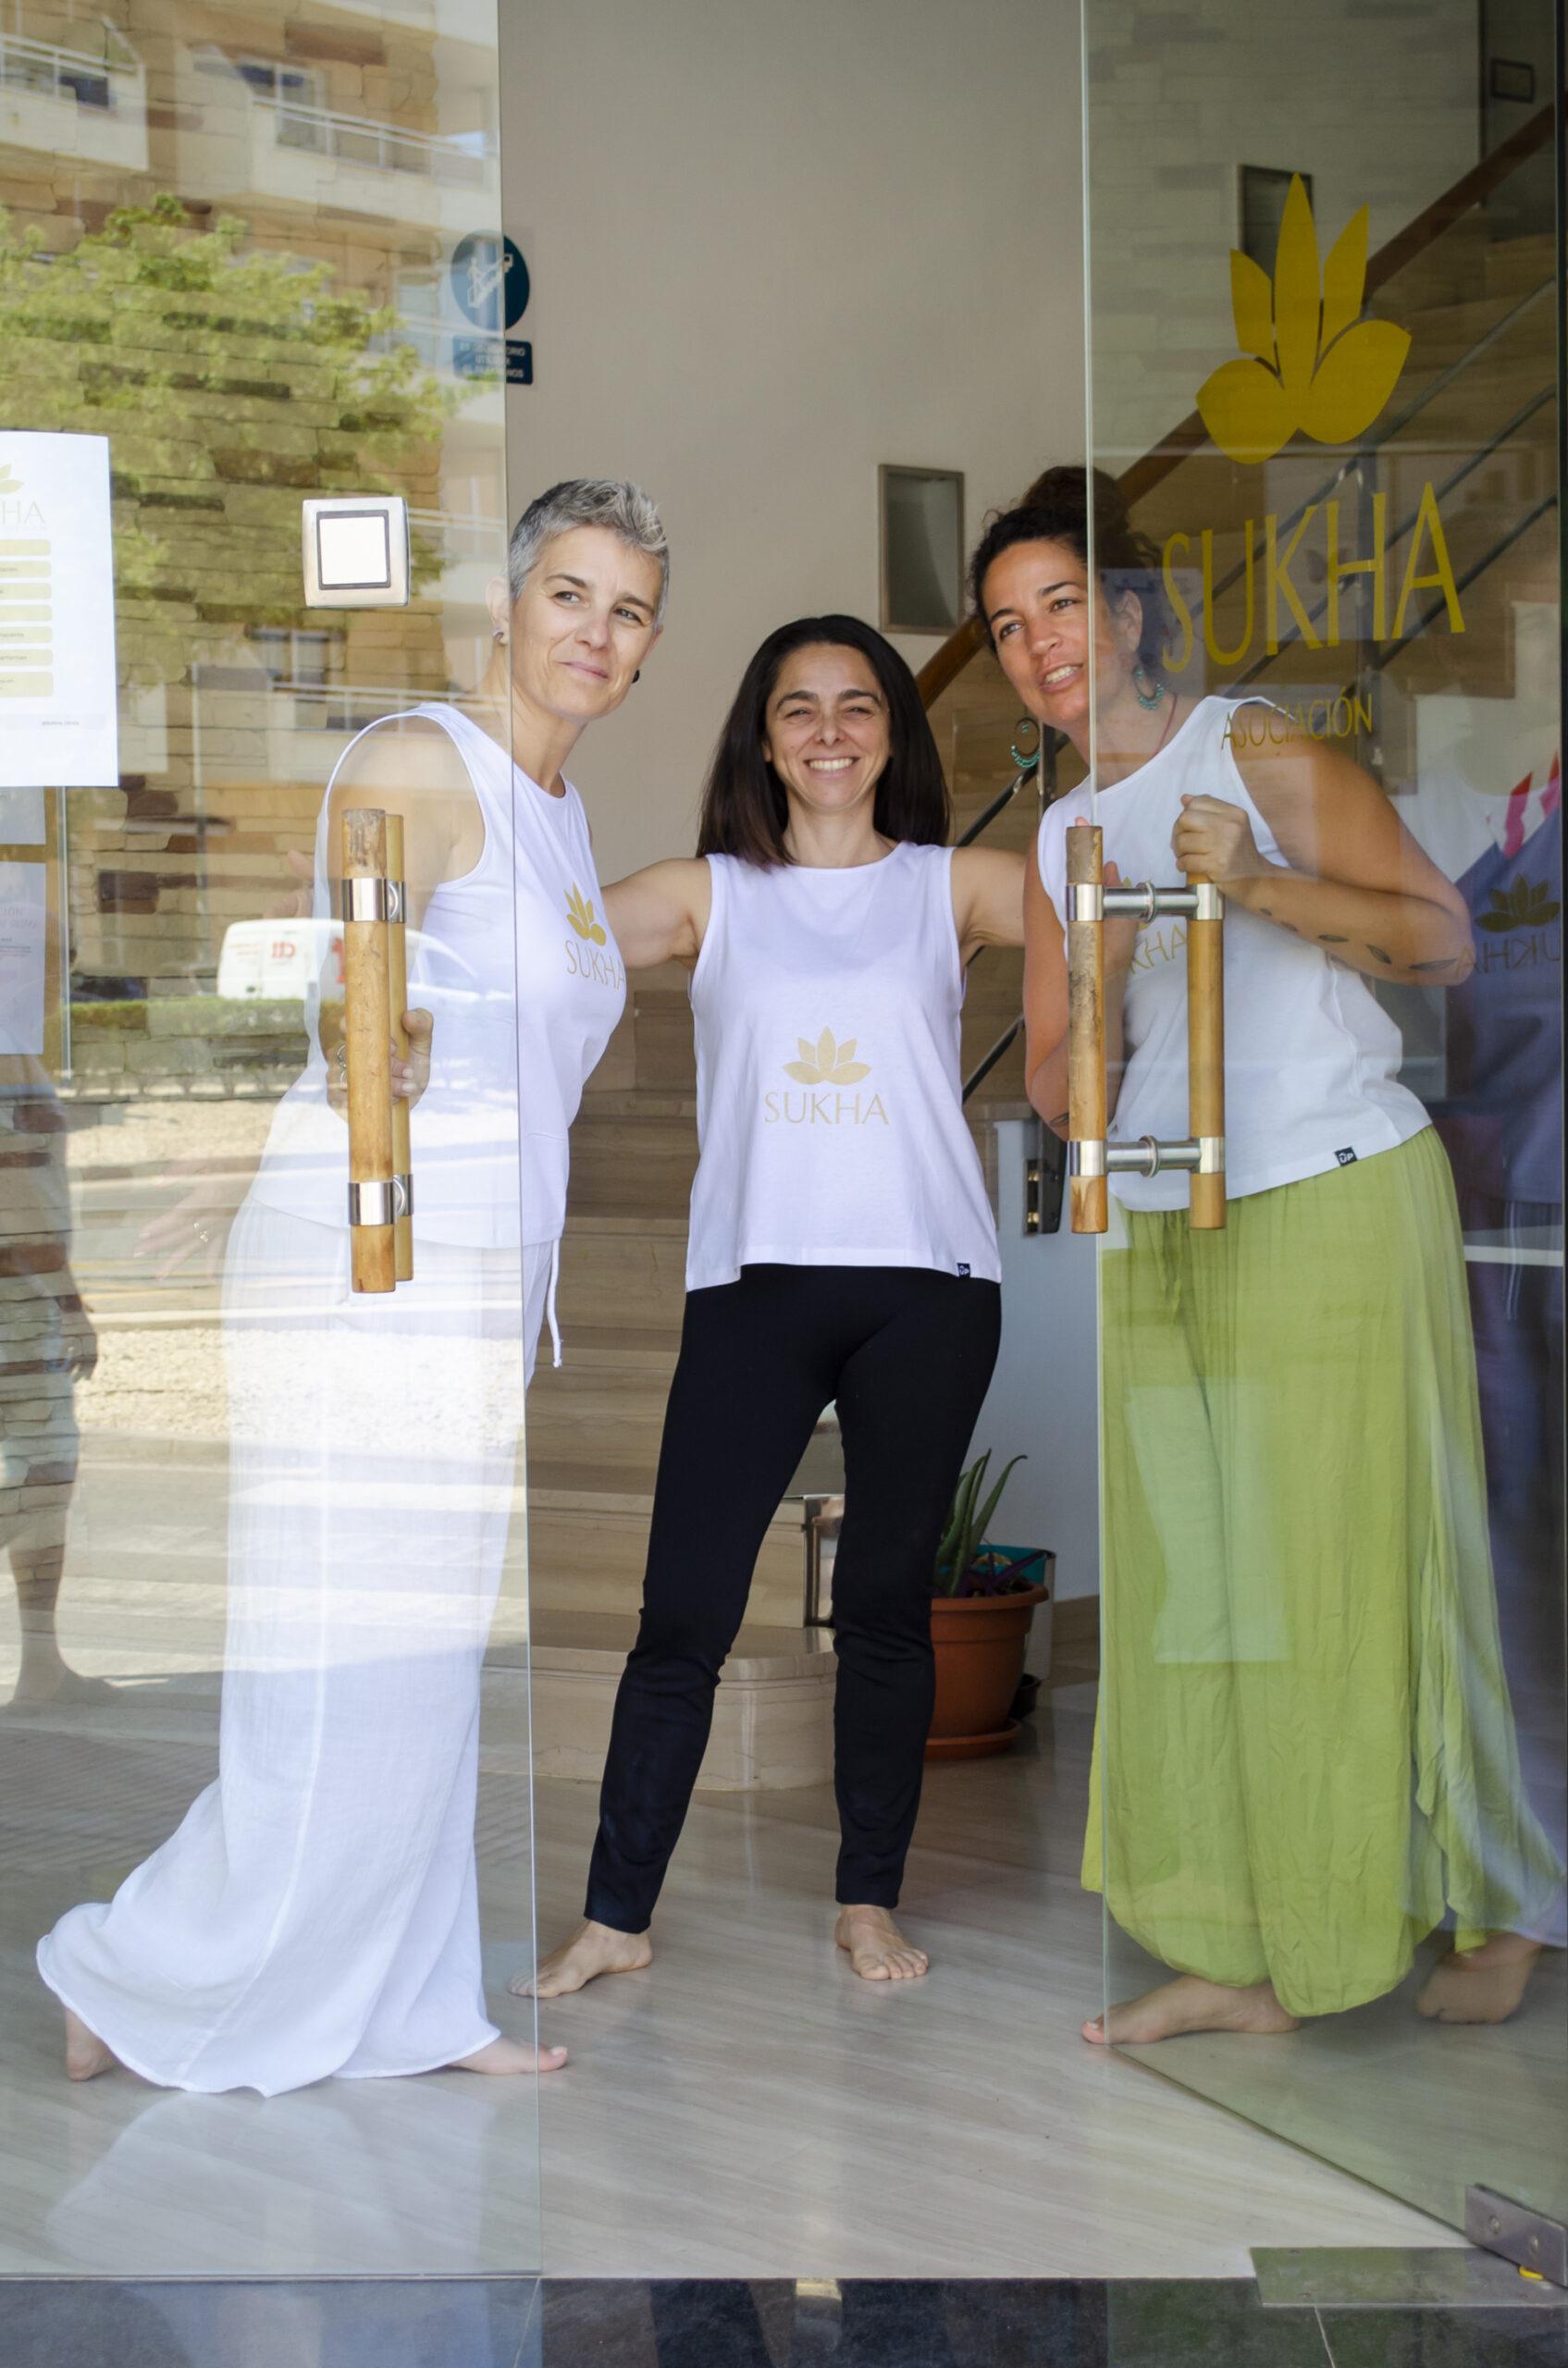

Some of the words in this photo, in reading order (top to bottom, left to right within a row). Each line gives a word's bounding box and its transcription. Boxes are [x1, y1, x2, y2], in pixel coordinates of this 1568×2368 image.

[1162, 481, 1466, 674] SUKHA
[1221, 685, 1373, 750] ASOCIACIÓN
[564, 940, 626, 991] SUKHA
[764, 1092, 889, 1126] SUKHA
